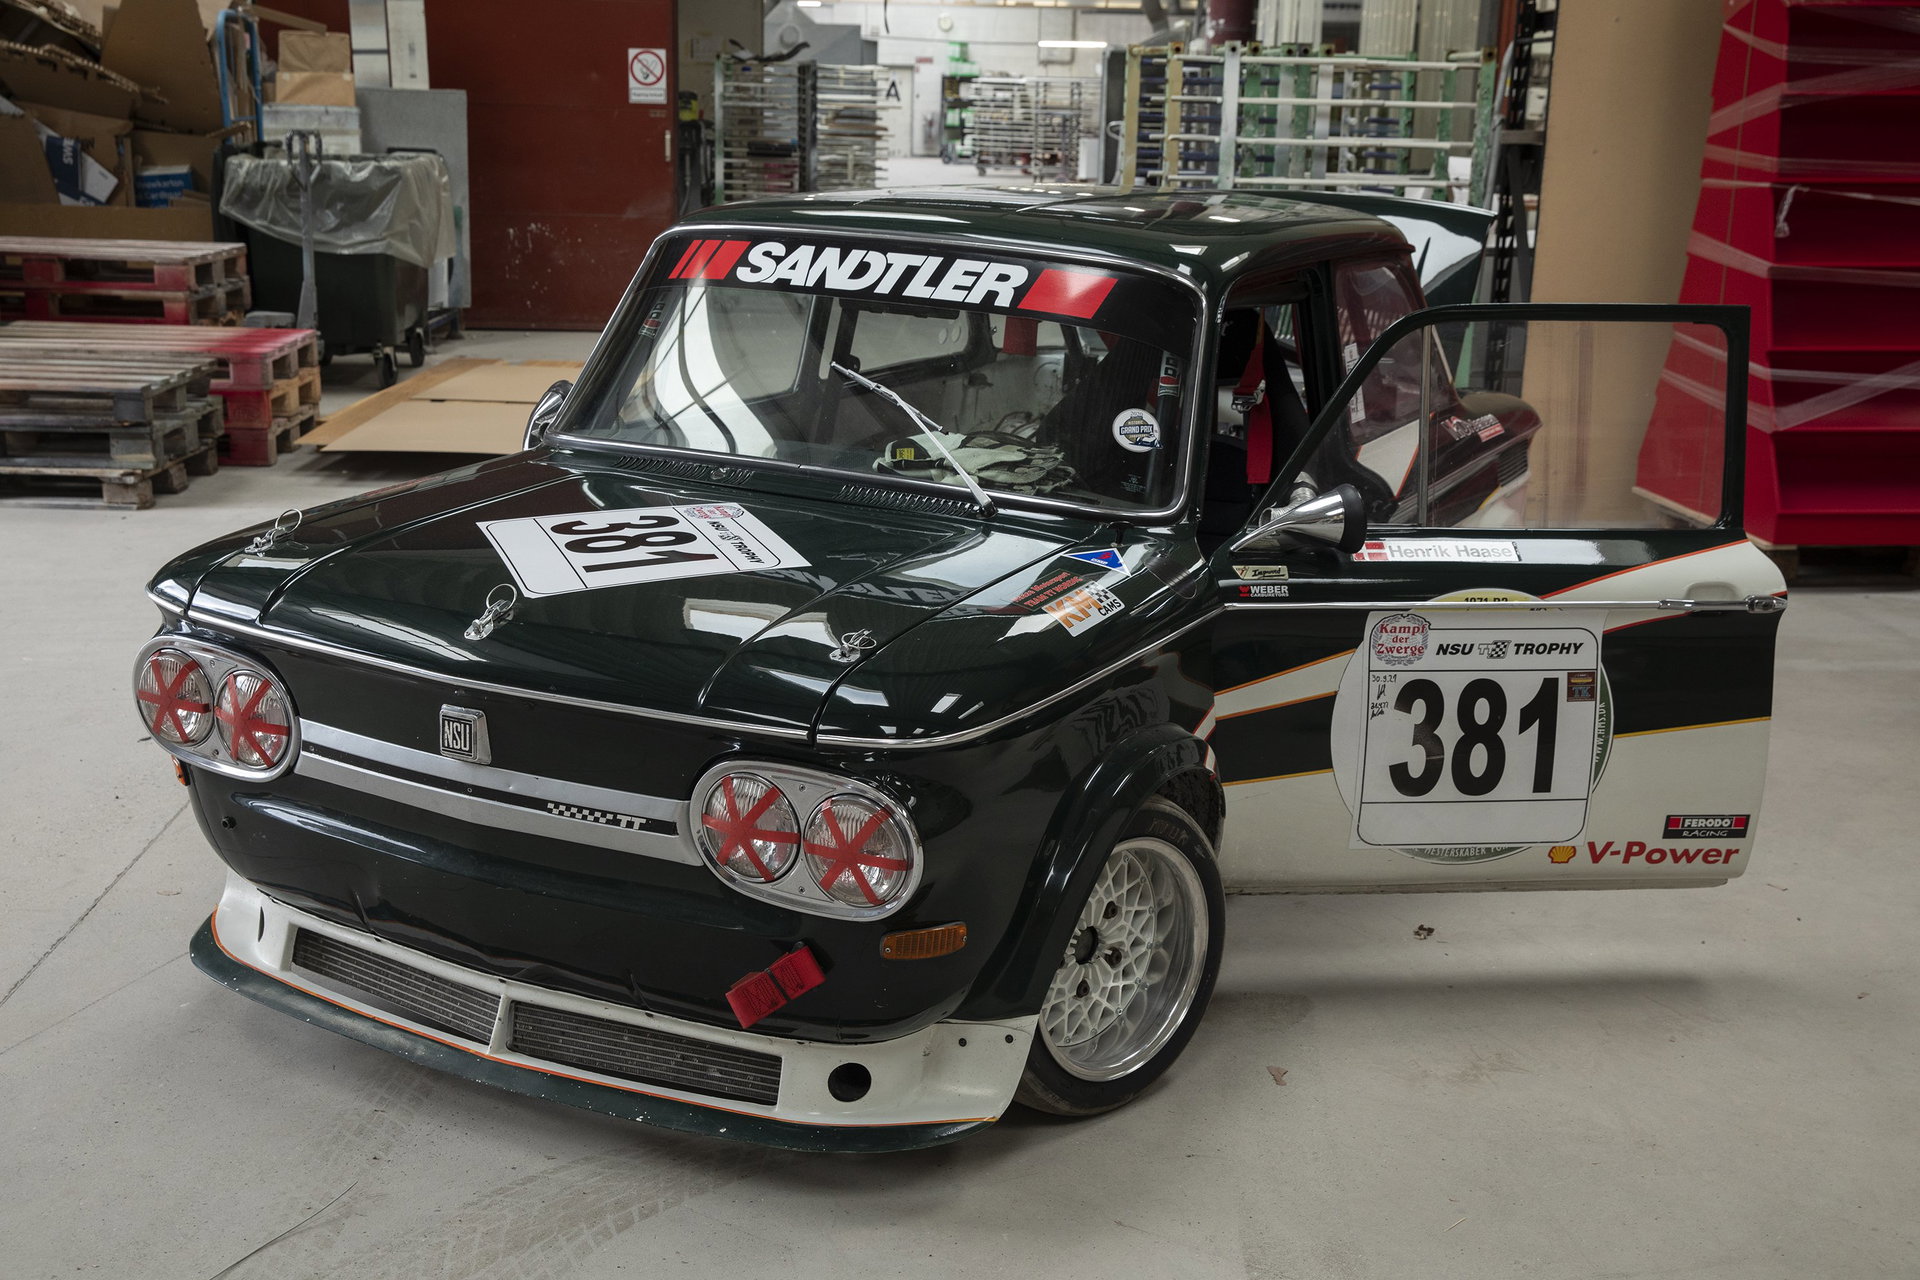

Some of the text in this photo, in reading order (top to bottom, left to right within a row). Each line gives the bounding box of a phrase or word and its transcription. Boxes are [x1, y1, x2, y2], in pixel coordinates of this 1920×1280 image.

[736, 241, 999, 308] SANDTLER
[1120, 425, 1153, 434] GRAND PRIX
[550, 515, 719, 573] 381
[1388, 544, 1513, 558] Henrik Haase
[1250, 585, 1289, 594] WEBER
[1097, 599, 1122, 617] CAMS
[1379, 624, 1428, 636] Kampf
[1391, 635, 1410, 643] der
[1376, 643, 1425, 656] Zwerge
[1436, 643, 1475, 655] NSU
[1514, 643, 1584, 655] TROPHY
[443, 720, 470, 752] NSU
[1388, 677, 1560, 797] 381
[617, 814, 647, 830] TT
[1683, 818, 1732, 828] FERODO
[1681, 829, 1729, 837] RACING
[1587, 841, 1741, 865] V-Power
